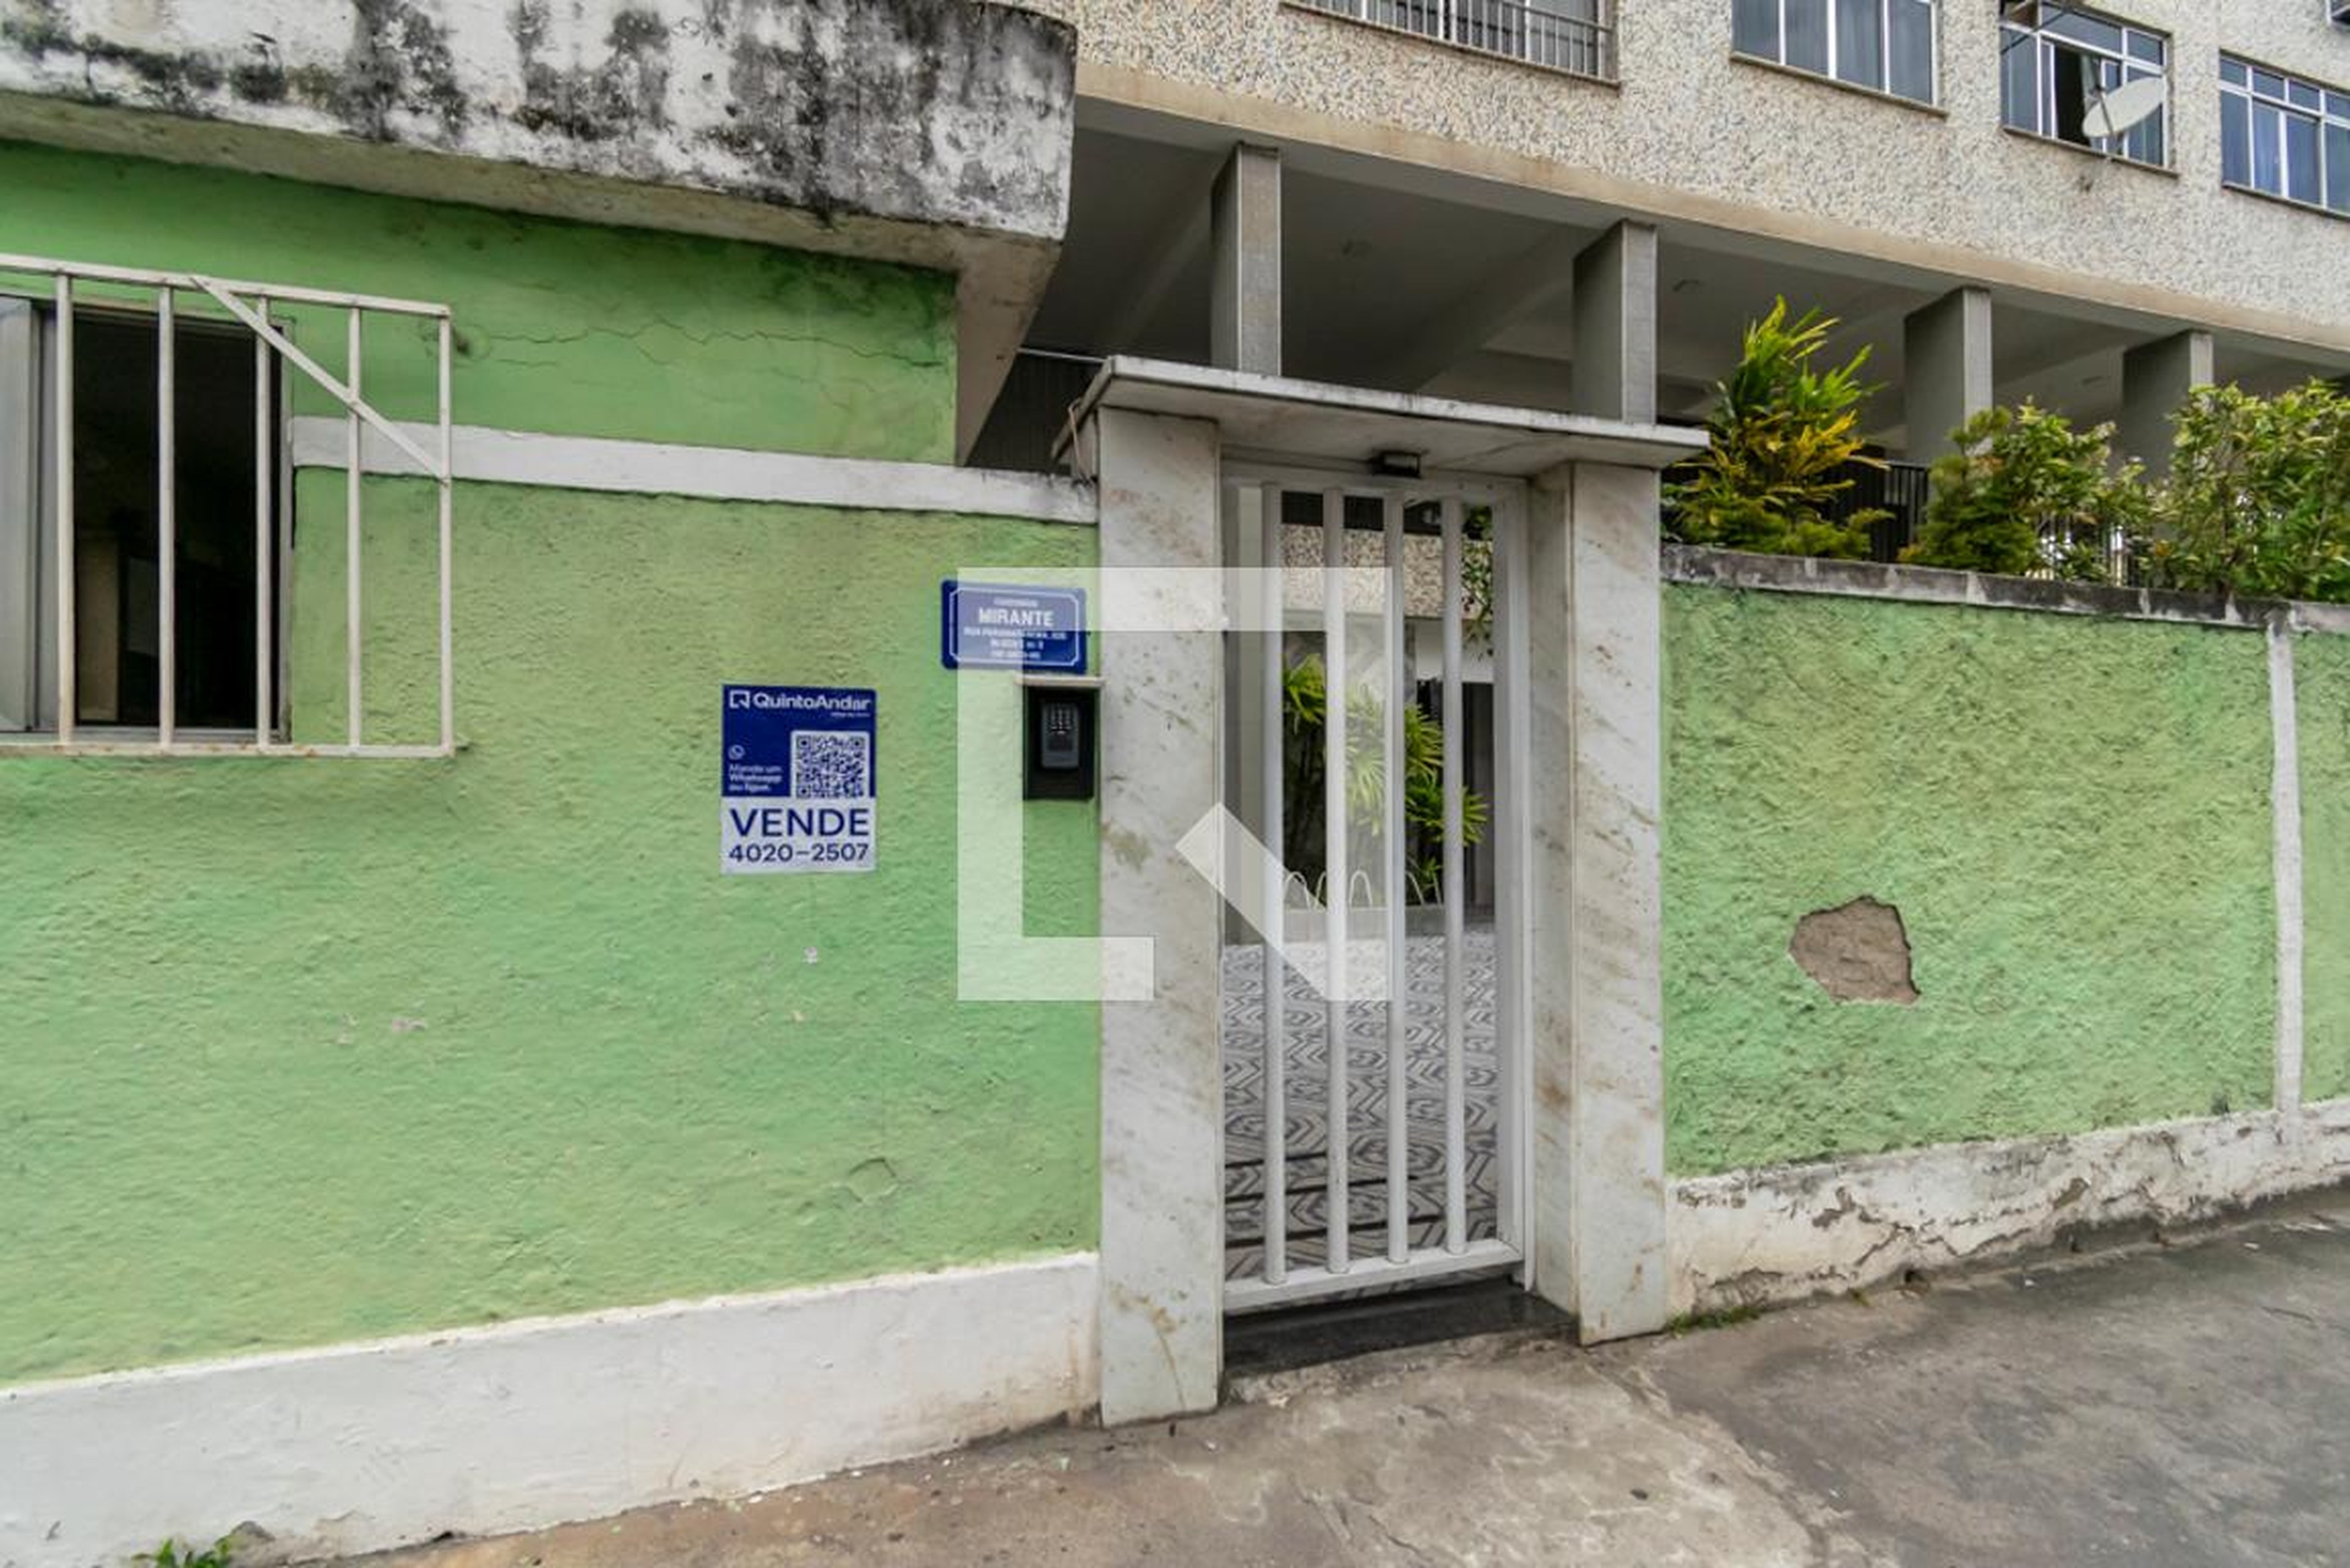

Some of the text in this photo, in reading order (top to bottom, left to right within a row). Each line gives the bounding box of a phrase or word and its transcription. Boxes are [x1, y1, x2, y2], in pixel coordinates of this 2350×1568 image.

[979, 607, 1054, 627] MIRANTE
[753, 692, 870, 710] QuintoAndar
[730, 808, 869, 837] VENDE
[729, 843, 869, 862] 4020-2507
